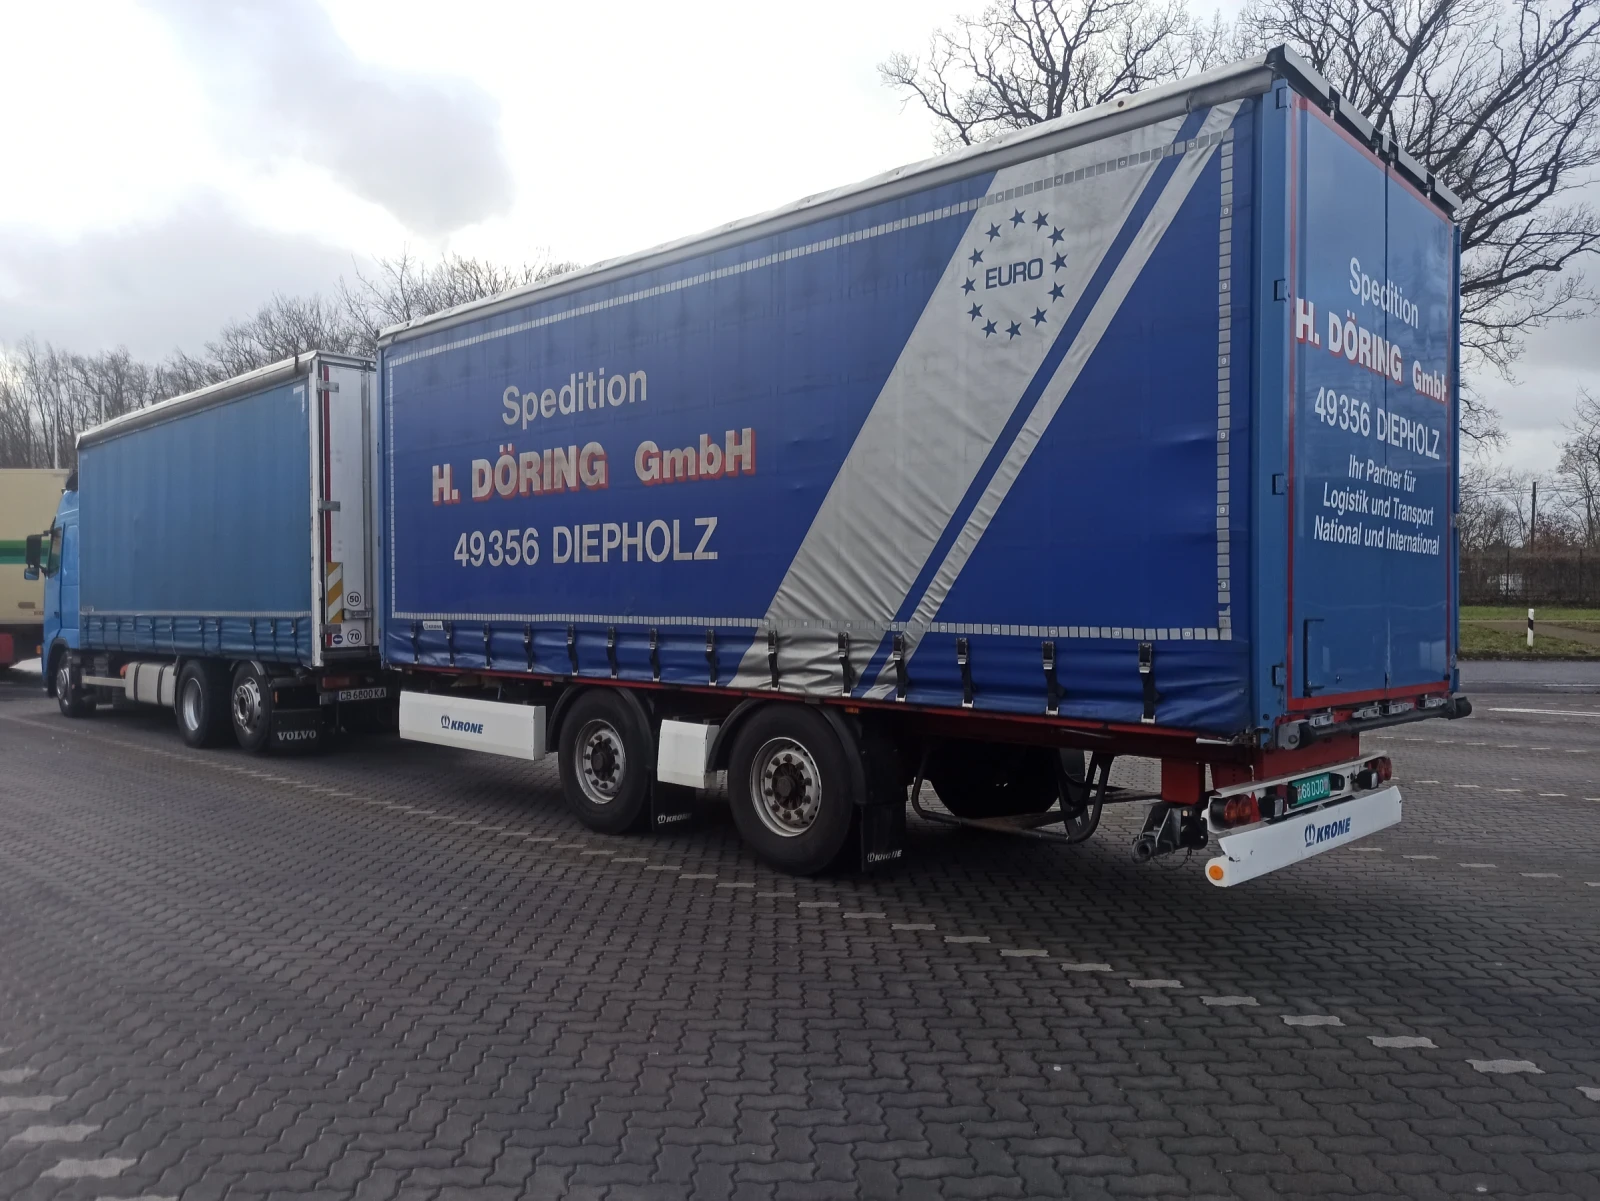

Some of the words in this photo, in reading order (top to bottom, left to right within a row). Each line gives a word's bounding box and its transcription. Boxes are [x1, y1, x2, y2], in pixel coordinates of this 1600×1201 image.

[986, 258, 1043, 289] EURO
[1349, 257, 1418, 329] Spedition
[1296, 297, 1320, 346] H.
[1328, 309, 1402, 384] DÖRING
[502, 367, 647, 430] Spedition
[1314, 386, 1371, 437] 49356
[1376, 407, 1440, 460] DIEPHOLZ
[432, 463, 459, 505] H.
[471, 441, 608, 499] DÖRING
[634, 428, 755, 485] GmbH
[1348, 454, 1364, 480] Ihr
[1366, 459, 1402, 490] Partner
[1403, 469, 1416, 493] für
[1323, 482, 1368, 515] Logistik
[1371, 496, 1391, 518] und
[1393, 497, 1433, 529] Transport
[454, 527, 540, 567] 49356
[552, 517, 718, 563] DIEPHOLZ
[1314, 515, 1362, 545] National
[1364, 526, 1385, 548] und
[1386, 527, 1440, 556] International
[349, 595, 360, 603] 50
[349, 633, 360, 641] 70
[277, 730, 316, 741] VOLVO
[450, 720, 484, 734] KRONE
[1316, 816, 1351, 844] KRONE
